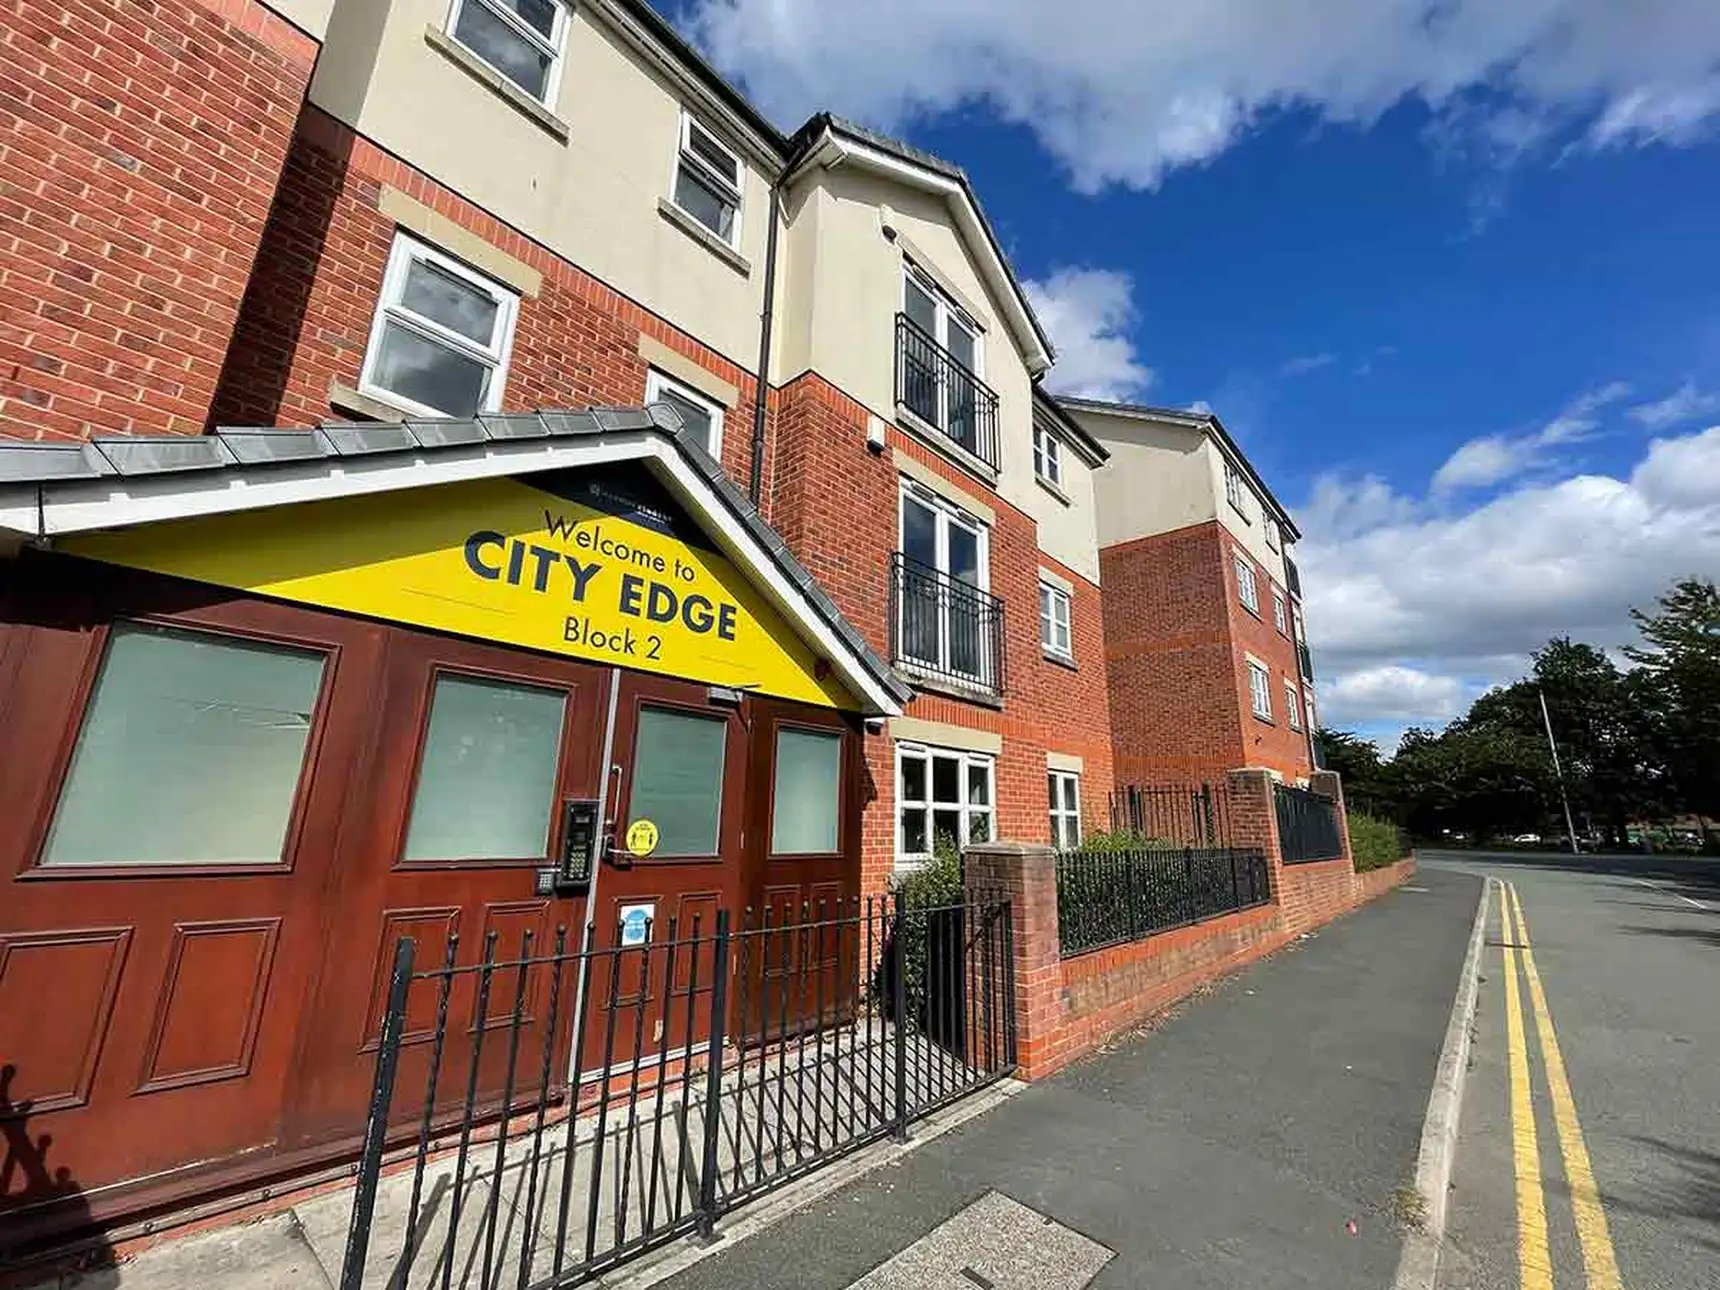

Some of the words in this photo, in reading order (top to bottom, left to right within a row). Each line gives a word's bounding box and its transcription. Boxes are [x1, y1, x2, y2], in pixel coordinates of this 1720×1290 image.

[544, 511, 665, 572] Welcome
[675, 558, 695, 582] to
[464, 530, 602, 602] CITY
[618, 573, 737, 641] EDGE
[564, 616, 636, 655] Block
[646, 636, 662, 660] 2
